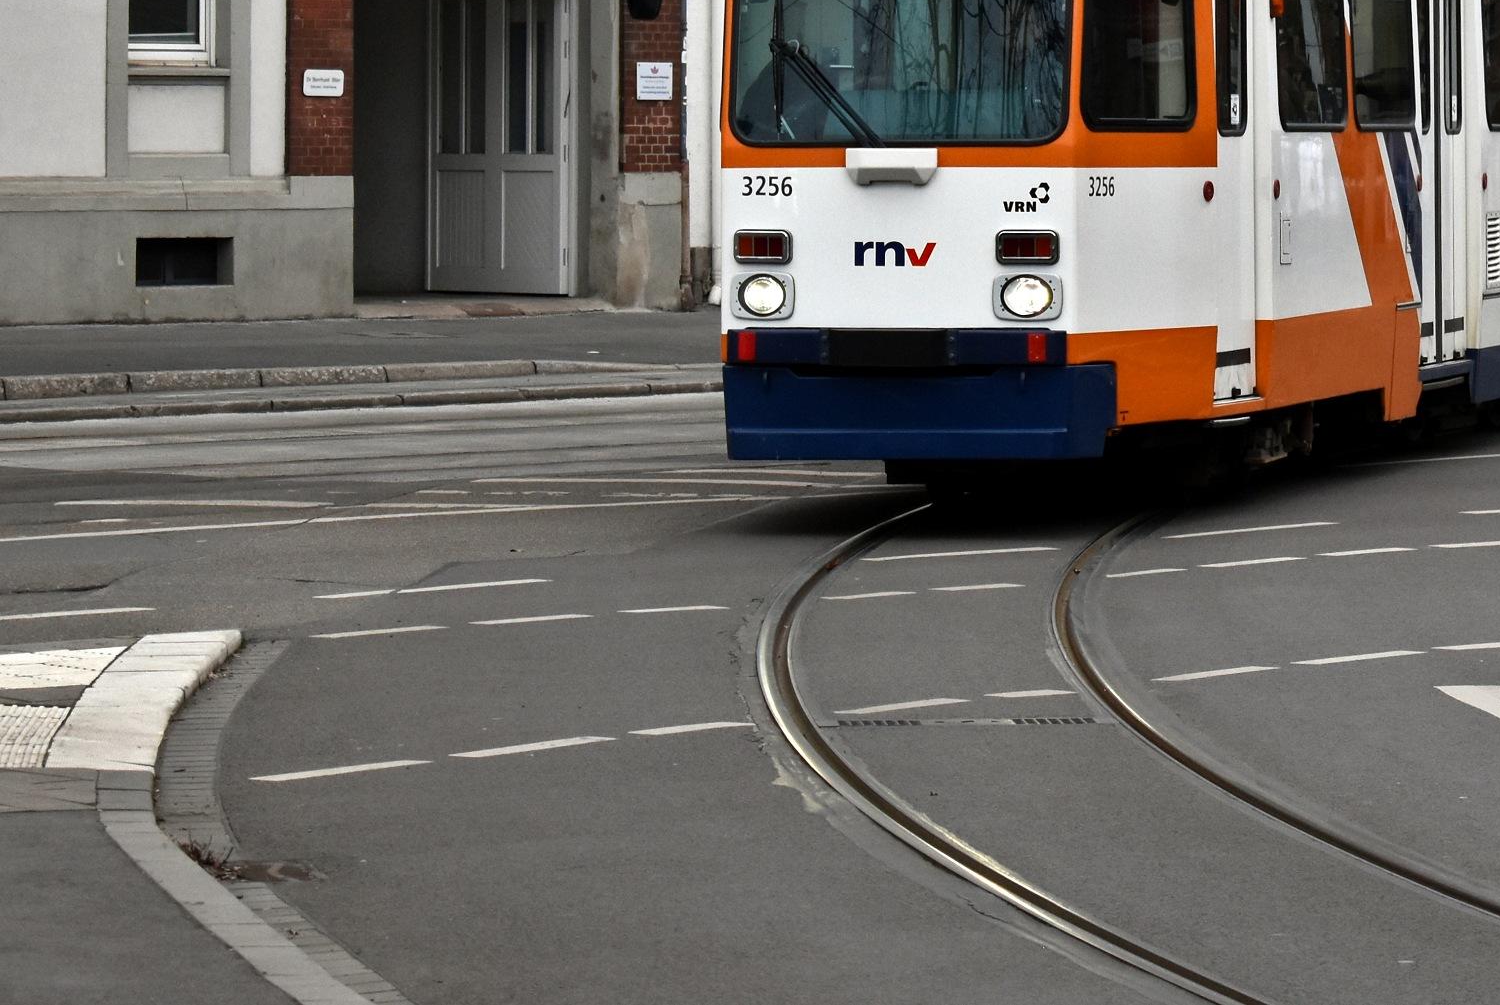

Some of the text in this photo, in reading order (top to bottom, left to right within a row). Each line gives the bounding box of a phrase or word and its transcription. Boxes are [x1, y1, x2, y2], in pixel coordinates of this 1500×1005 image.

[741, 175, 793, 197] 3256
[1088, 176, 1116, 197] 3256
[1003, 201, 1037, 213] VRN
[853, 240, 937, 267] rnv
